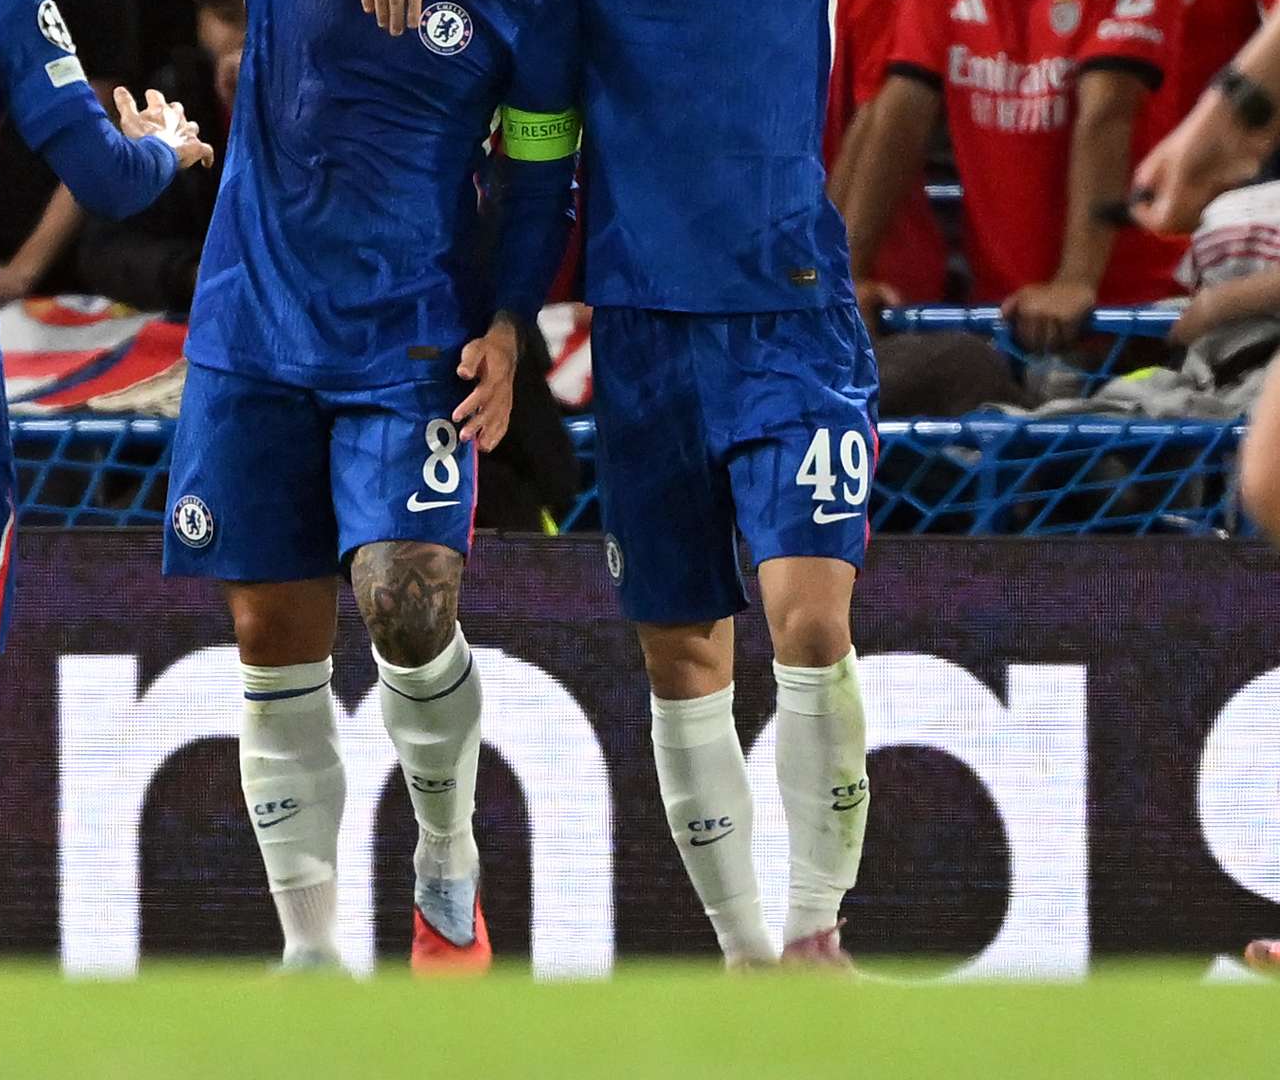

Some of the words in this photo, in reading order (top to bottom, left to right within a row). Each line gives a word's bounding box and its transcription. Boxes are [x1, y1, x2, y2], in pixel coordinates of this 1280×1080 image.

[423, 418, 460, 494] 8
[796, 428, 869, 505] 49
[832, 778, 866, 797] CFC
[254, 797, 297, 816] CFC
[688, 816, 733, 832] CFC
